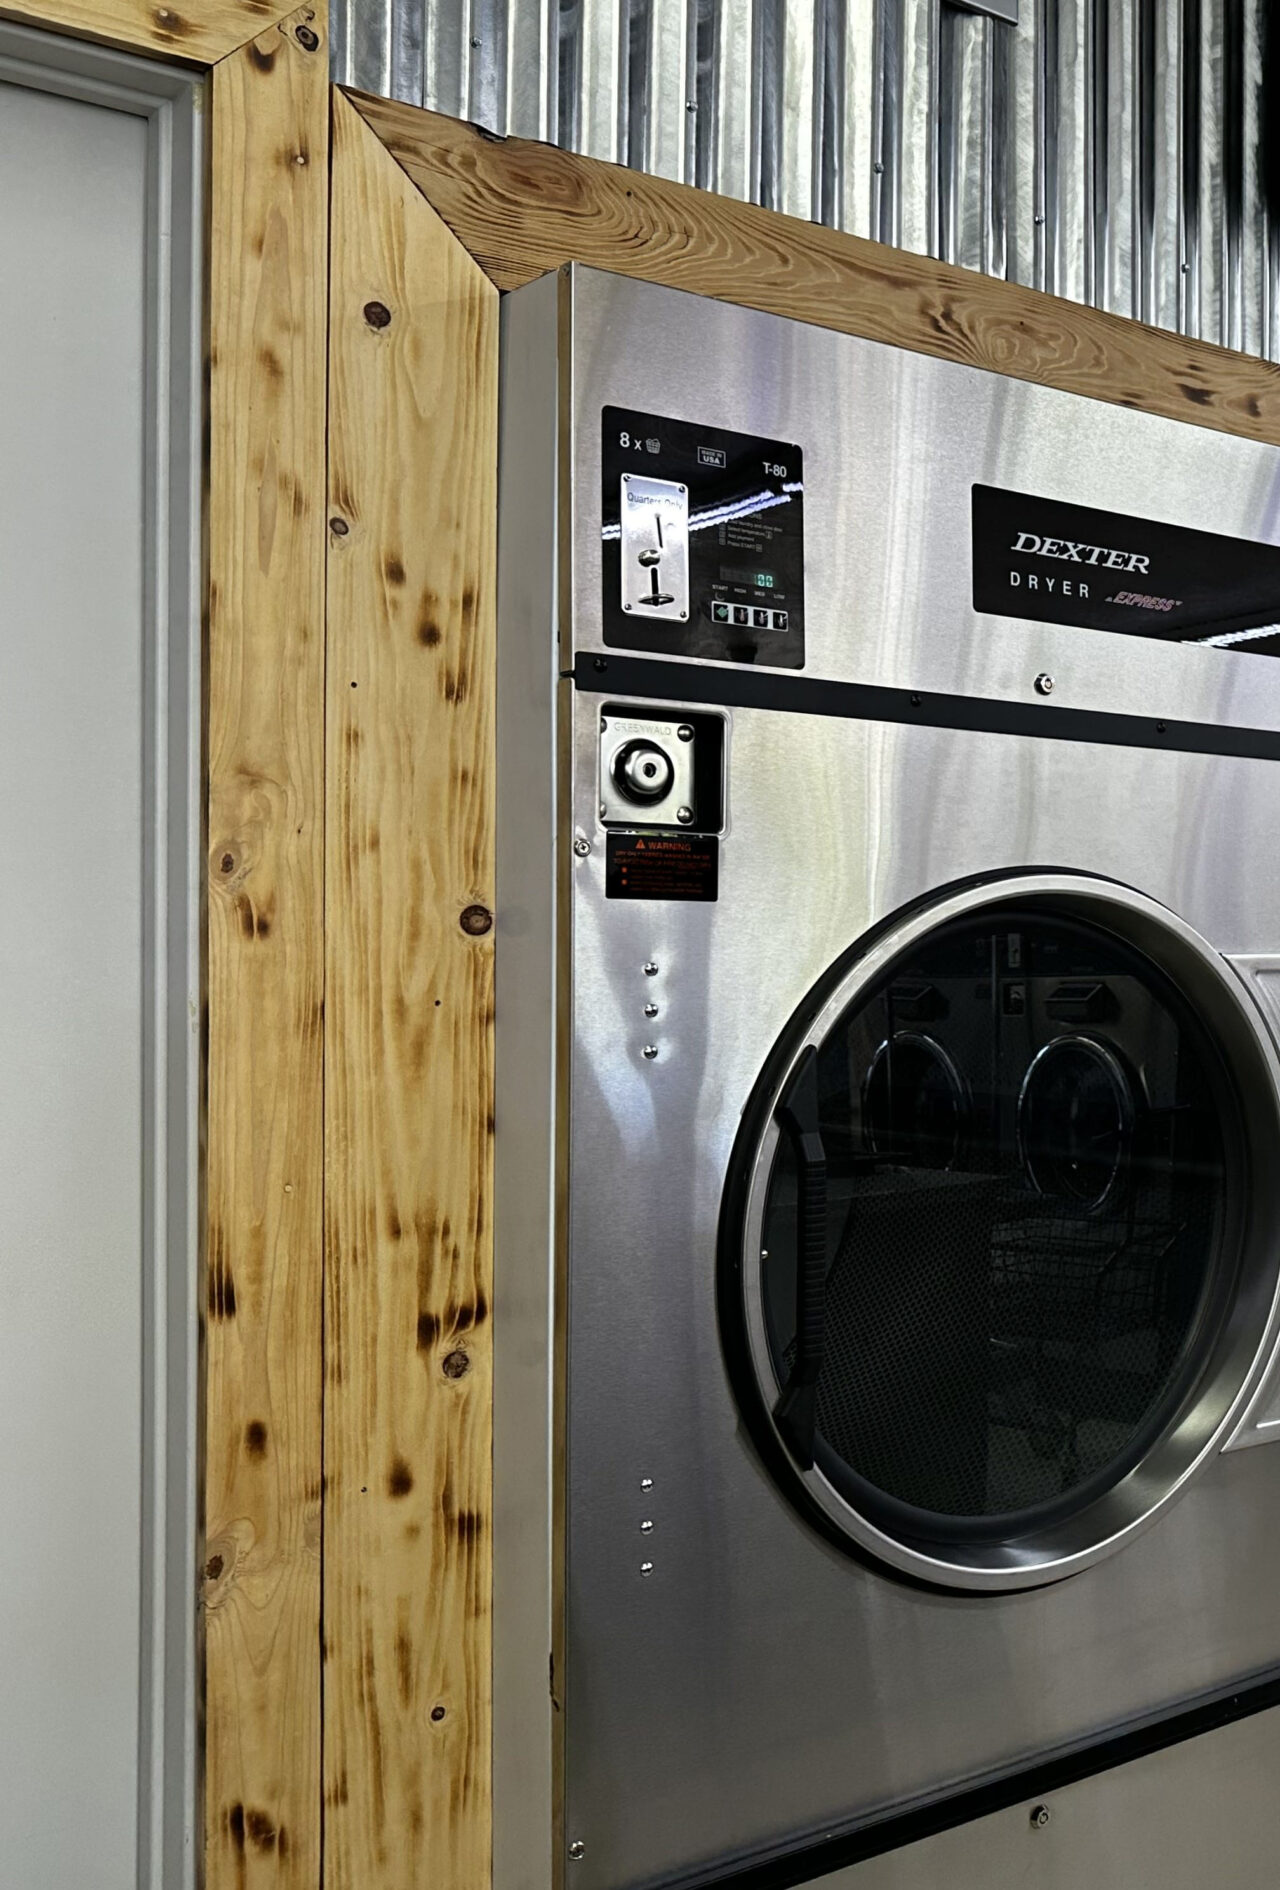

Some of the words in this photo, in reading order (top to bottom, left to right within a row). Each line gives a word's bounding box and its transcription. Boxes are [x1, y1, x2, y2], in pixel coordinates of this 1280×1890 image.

[619, 431, 630, 448] 8
[703, 455, 720, 465] USA
[762, 461, 787, 477] T-80
[1010, 531, 1151, 575] DEXTER
[1010, 571, 1090, 598] DRYER
[1112, 590, 1176, 612] EXPRESS
[614, 721, 672, 736] GREENWALD
[647, 841, 692, 852] WARNING
